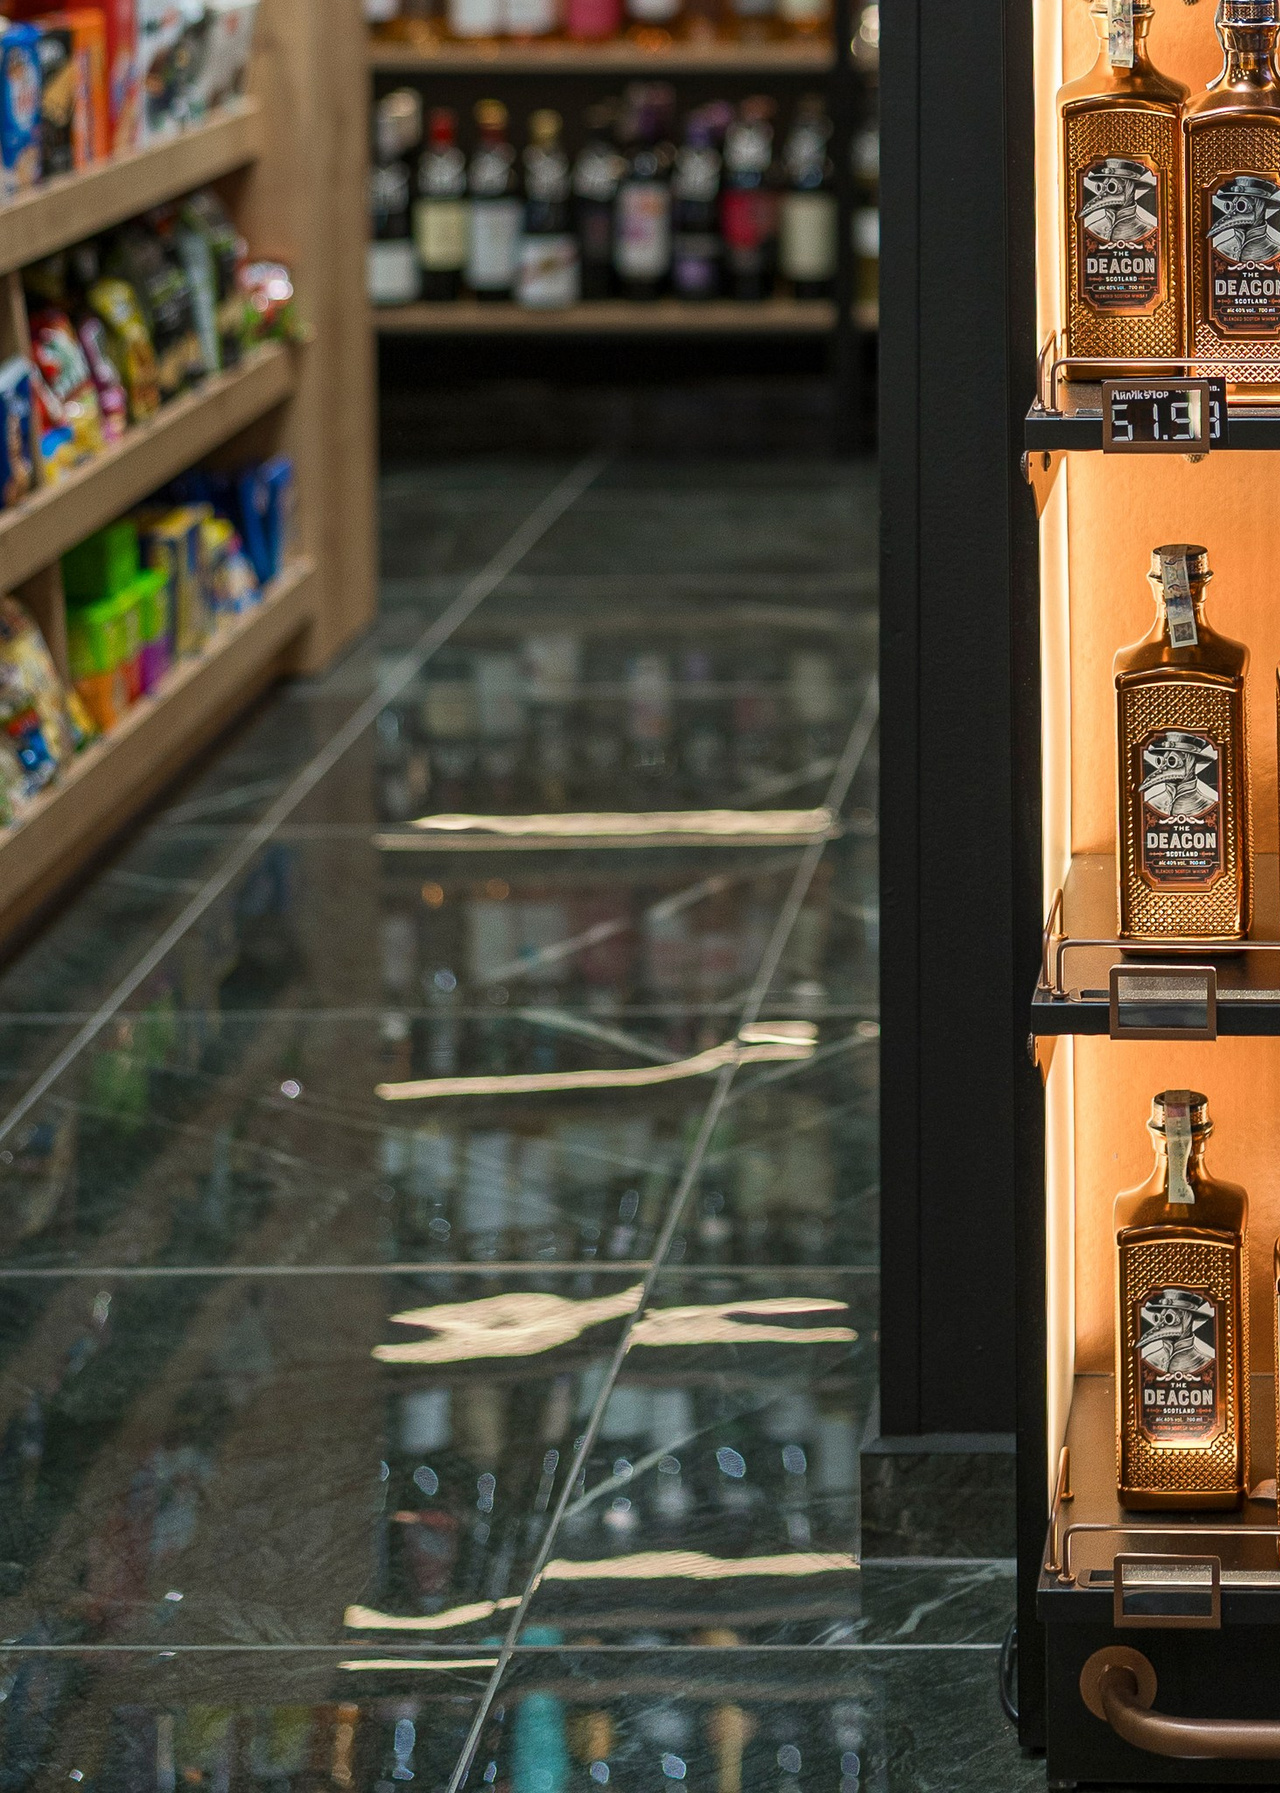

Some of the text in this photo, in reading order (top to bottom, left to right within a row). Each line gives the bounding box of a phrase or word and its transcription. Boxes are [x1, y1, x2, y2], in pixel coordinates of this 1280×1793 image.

[1087, 258, 1155, 274] DEACON
[1146, 833, 1217, 849] DEACON
[1144, 1389, 1213, 1405] DEACON
